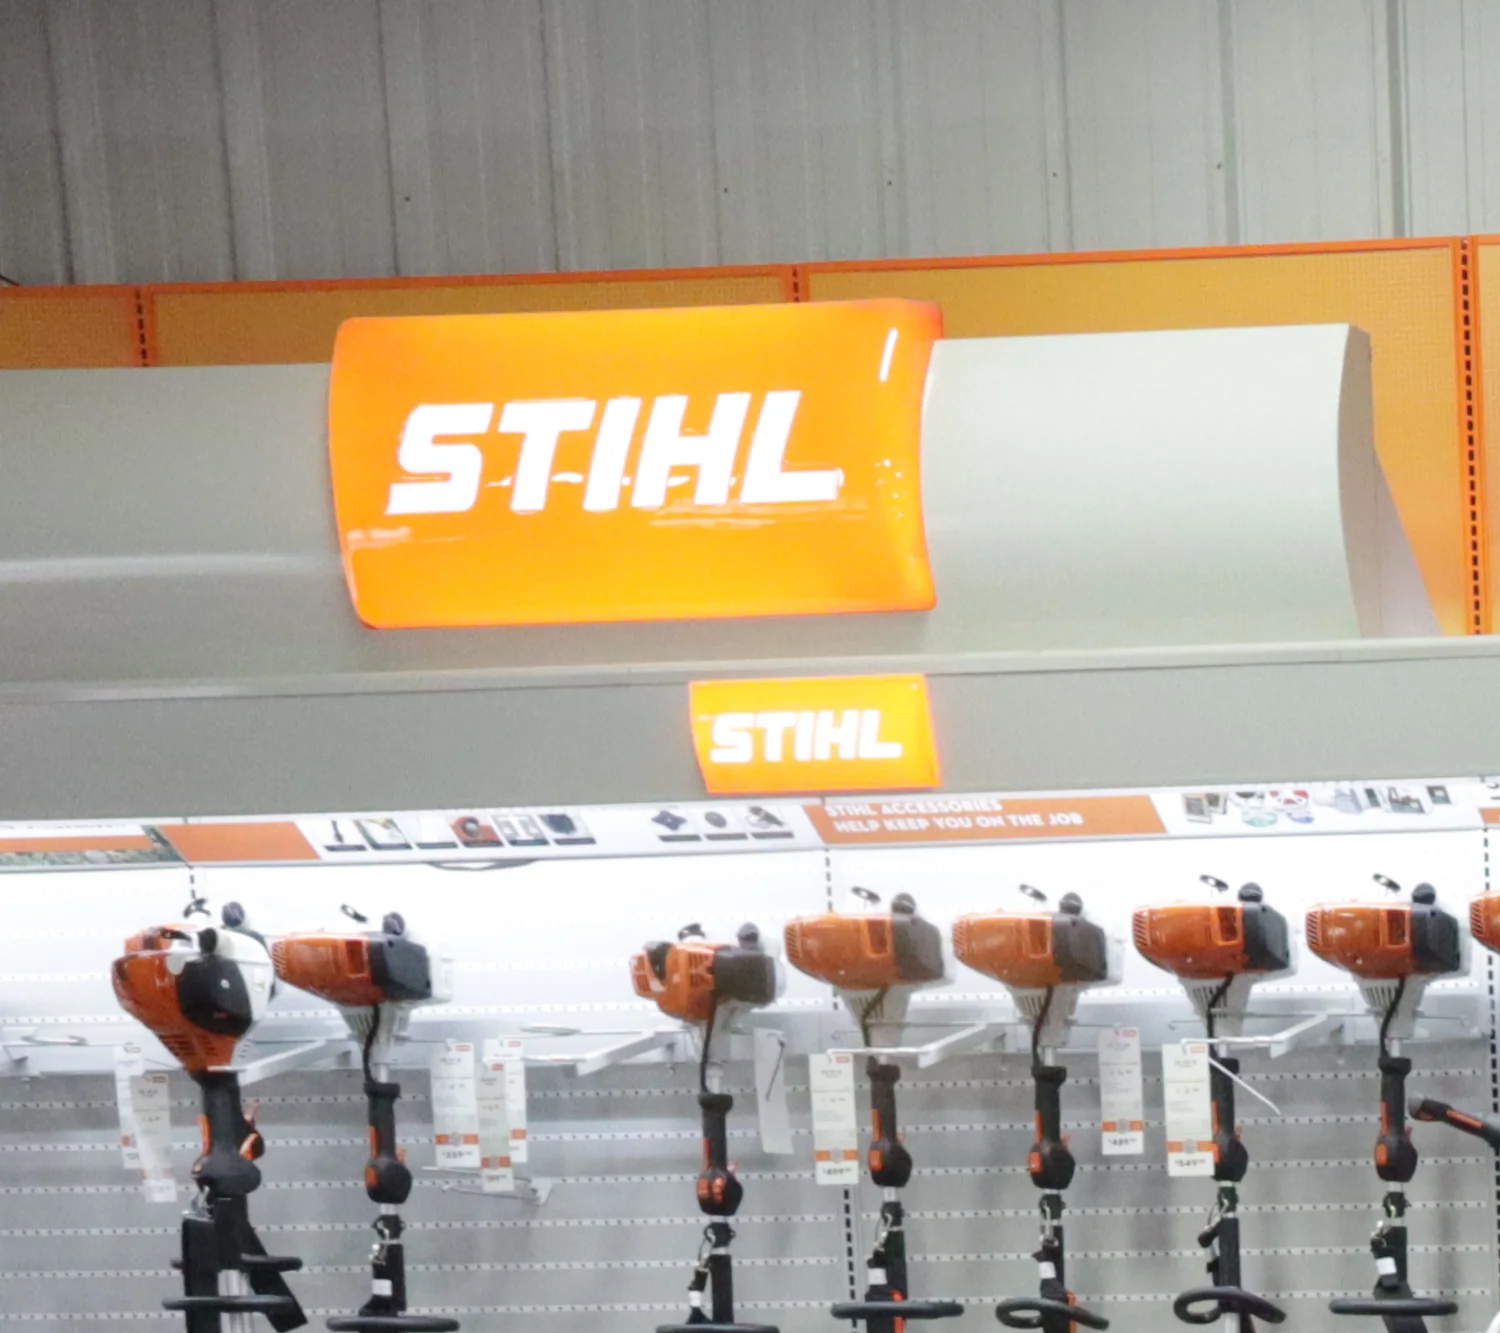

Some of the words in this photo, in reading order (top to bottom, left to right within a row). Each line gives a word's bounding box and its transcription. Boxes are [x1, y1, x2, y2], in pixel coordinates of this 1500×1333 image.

[387, 391, 842, 514] STIHL
[709, 709, 902, 763] STIHL
[824, 804, 877, 817] STIHL
[881, 799, 1003, 815] ACCESSORIES
[833, 818, 881, 833] HELP
[883, 817, 930, 831] KEEP
[933, 816, 973, 830] YOU
[975, 815, 1005, 828] ON
[1005, 813, 1045, 826] THE
[1048, 812, 1085, 826] JOB
